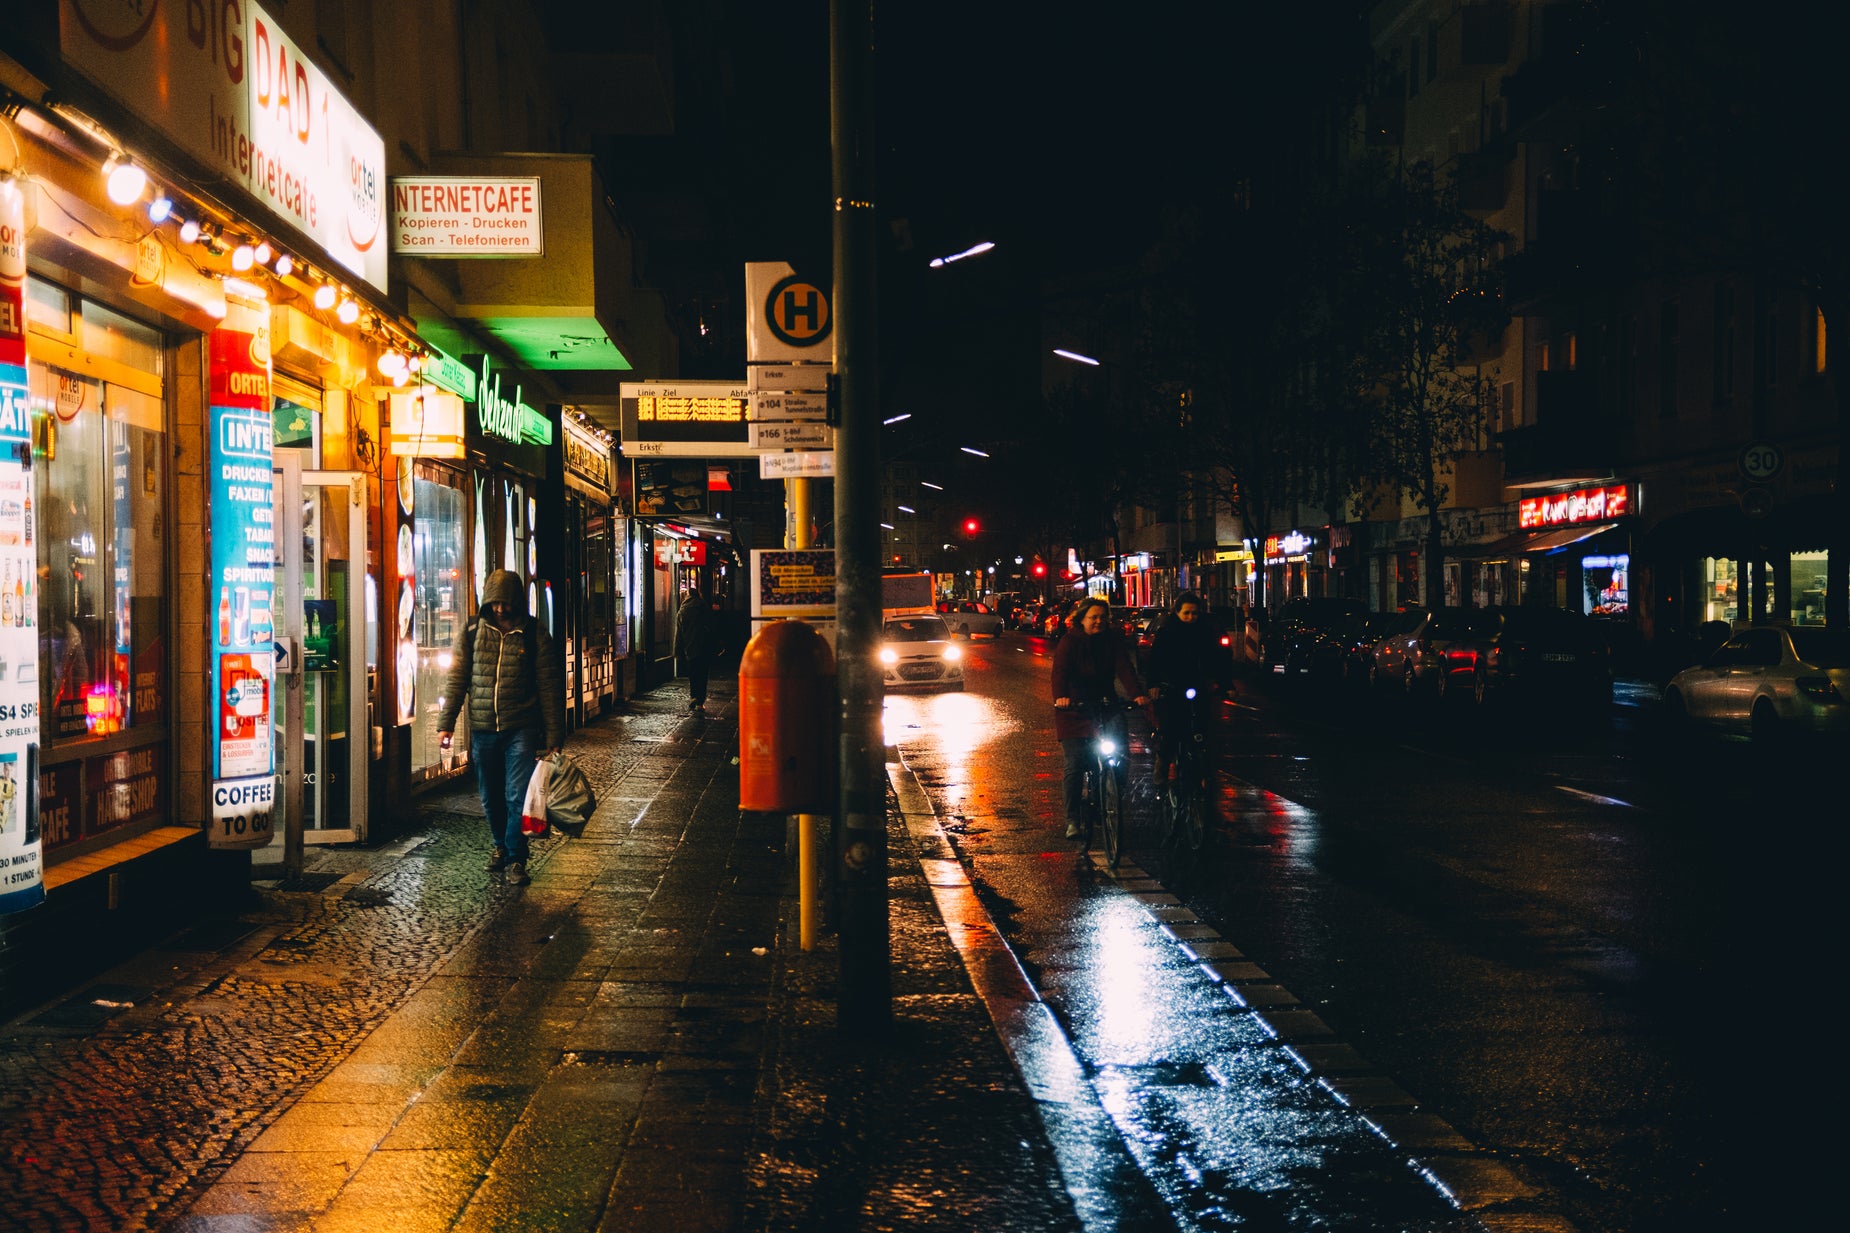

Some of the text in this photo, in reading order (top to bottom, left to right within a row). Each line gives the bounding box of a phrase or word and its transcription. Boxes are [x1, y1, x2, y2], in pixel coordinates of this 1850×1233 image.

[255, 15, 311, 145] DAD
[209, 93, 318, 229] Internetcafe
[351, 155, 375, 202] ortel
[399, 217, 459, 231] Kopieren
[473, 217, 527, 228] Drucken
[402, 234, 434, 246] Scan
[449, 234, 530, 246] Telefonieren
[784, 291, 818, 331] H
[59, 375, 80, 394] ortel
[230, 372, 268, 396] ORTEL
[637, 389, 656, 397] Linie
[663, 389, 677, 397] Ziel
[766, 400, 781, 408] 104
[765, 428, 780, 438] 166
[1748, 452, 1774, 471] 30
[215, 783, 271, 807] COFFEE
[222, 814, 269, 836] TO GO
